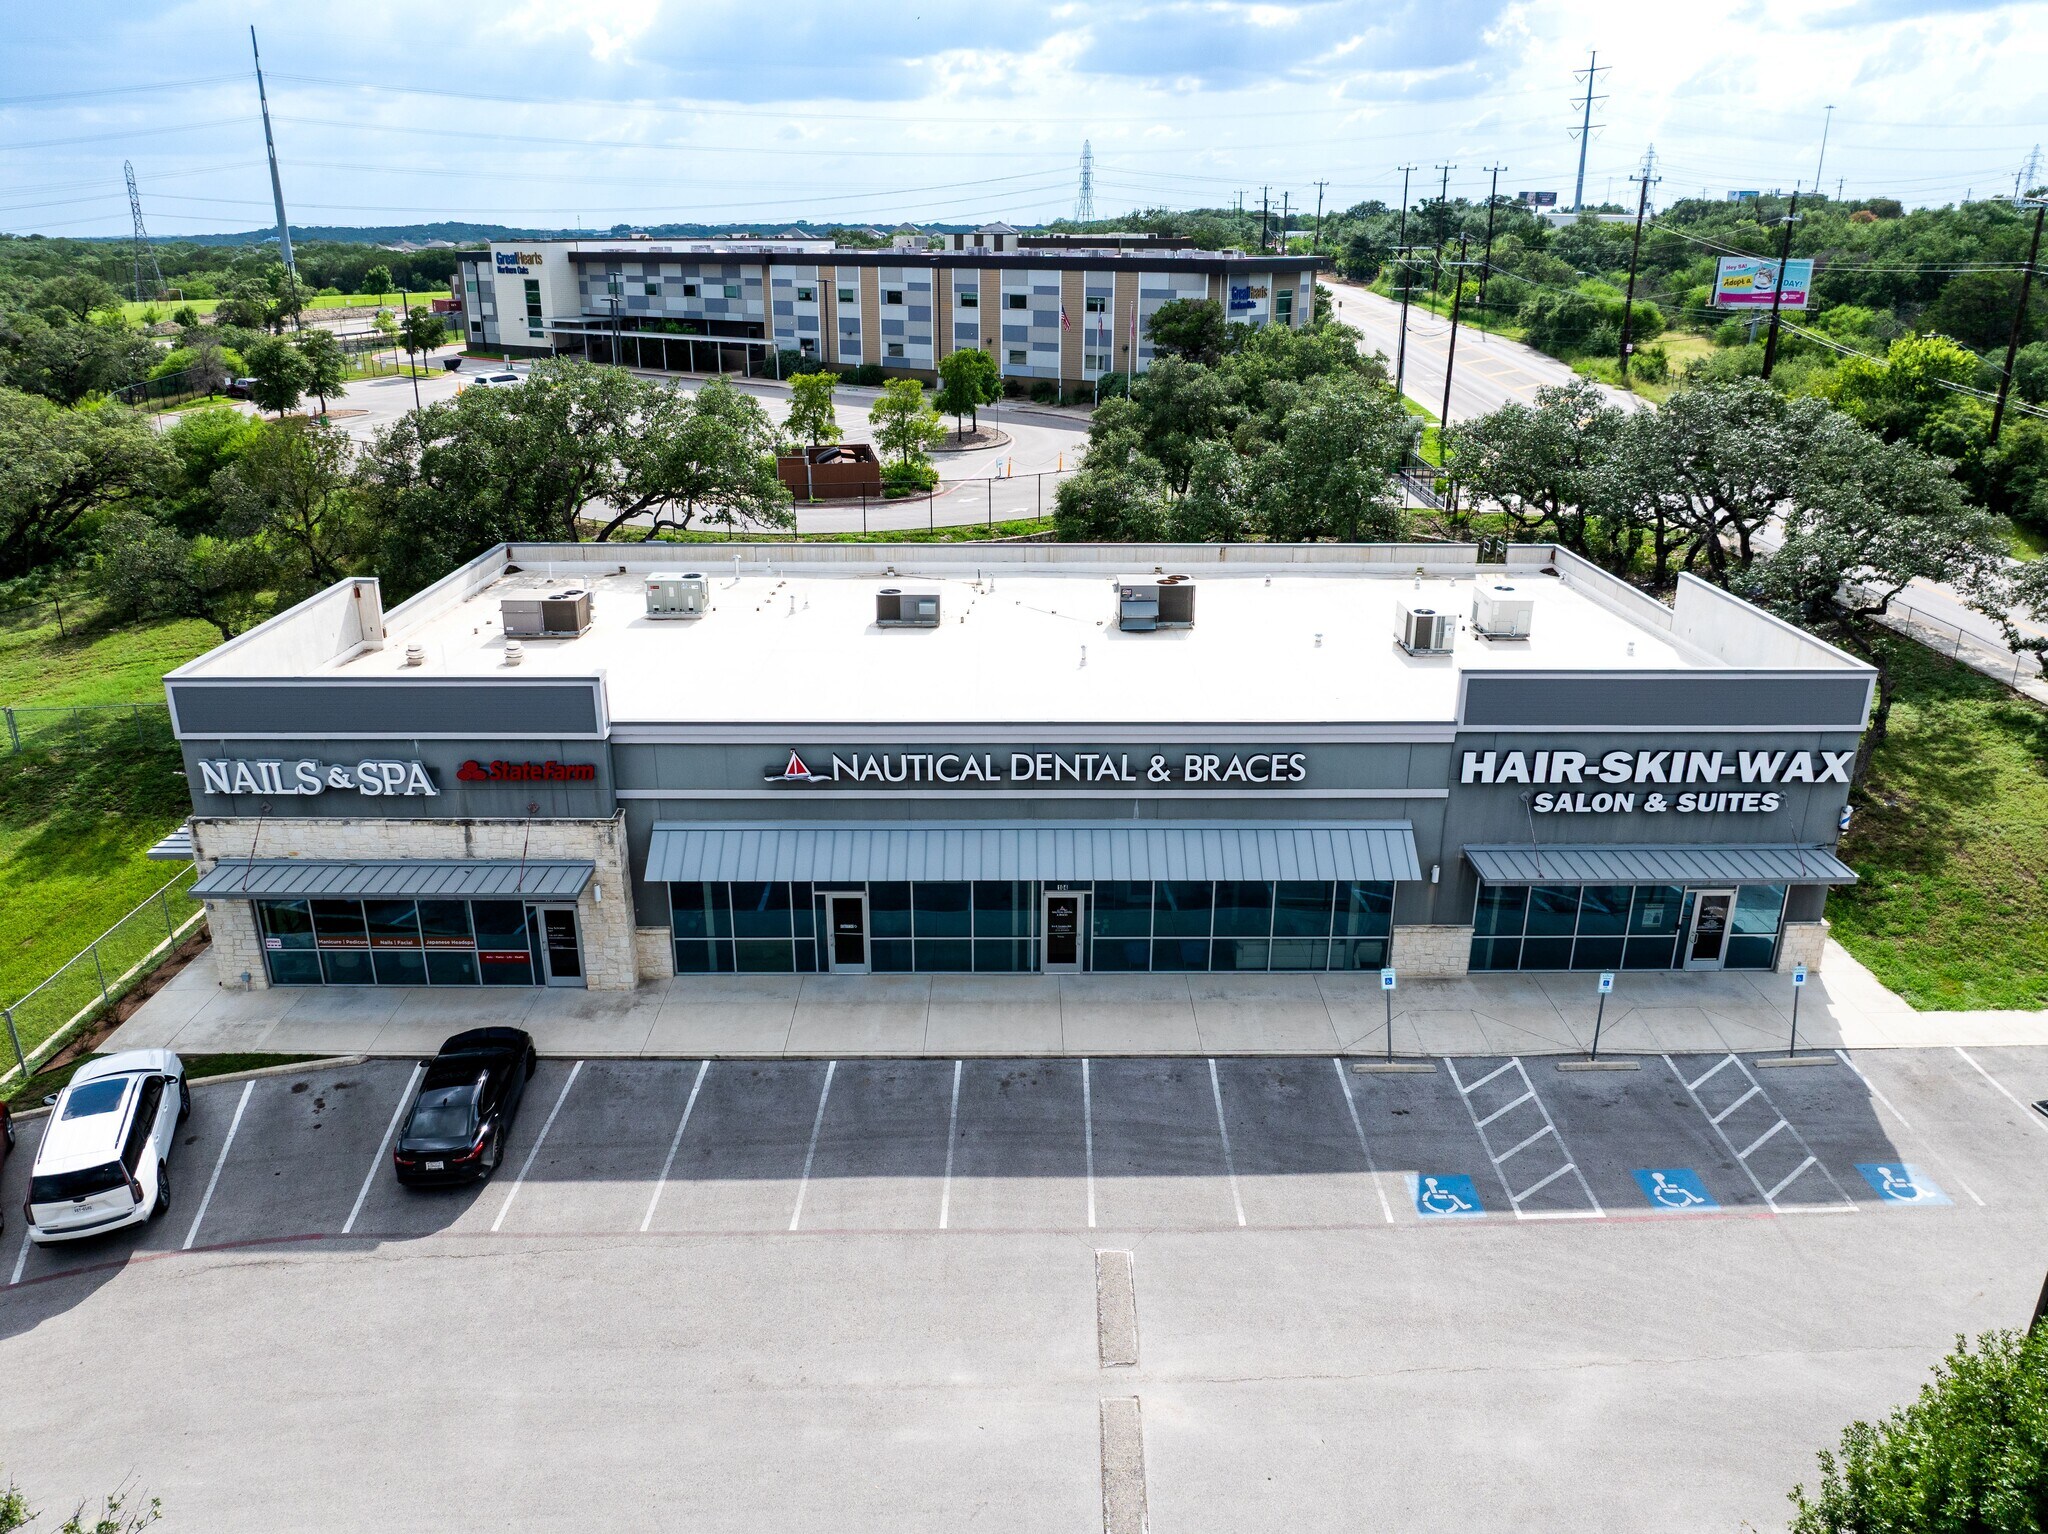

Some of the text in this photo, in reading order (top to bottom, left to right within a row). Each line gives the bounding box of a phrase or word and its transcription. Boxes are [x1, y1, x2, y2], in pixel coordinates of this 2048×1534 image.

[1723, 278, 1745, 287] Adopt
[1772, 278, 1803, 288] TDAY!
[198, 761, 438, 796] NAILS & SPA
[833, 753, 1306, 782] NAUTICAL DENTAL & BRACES
[1460, 750, 1855, 784] HAIR-SKIN-WAX
[1533, 792, 1780, 813] SALON & SUITES
